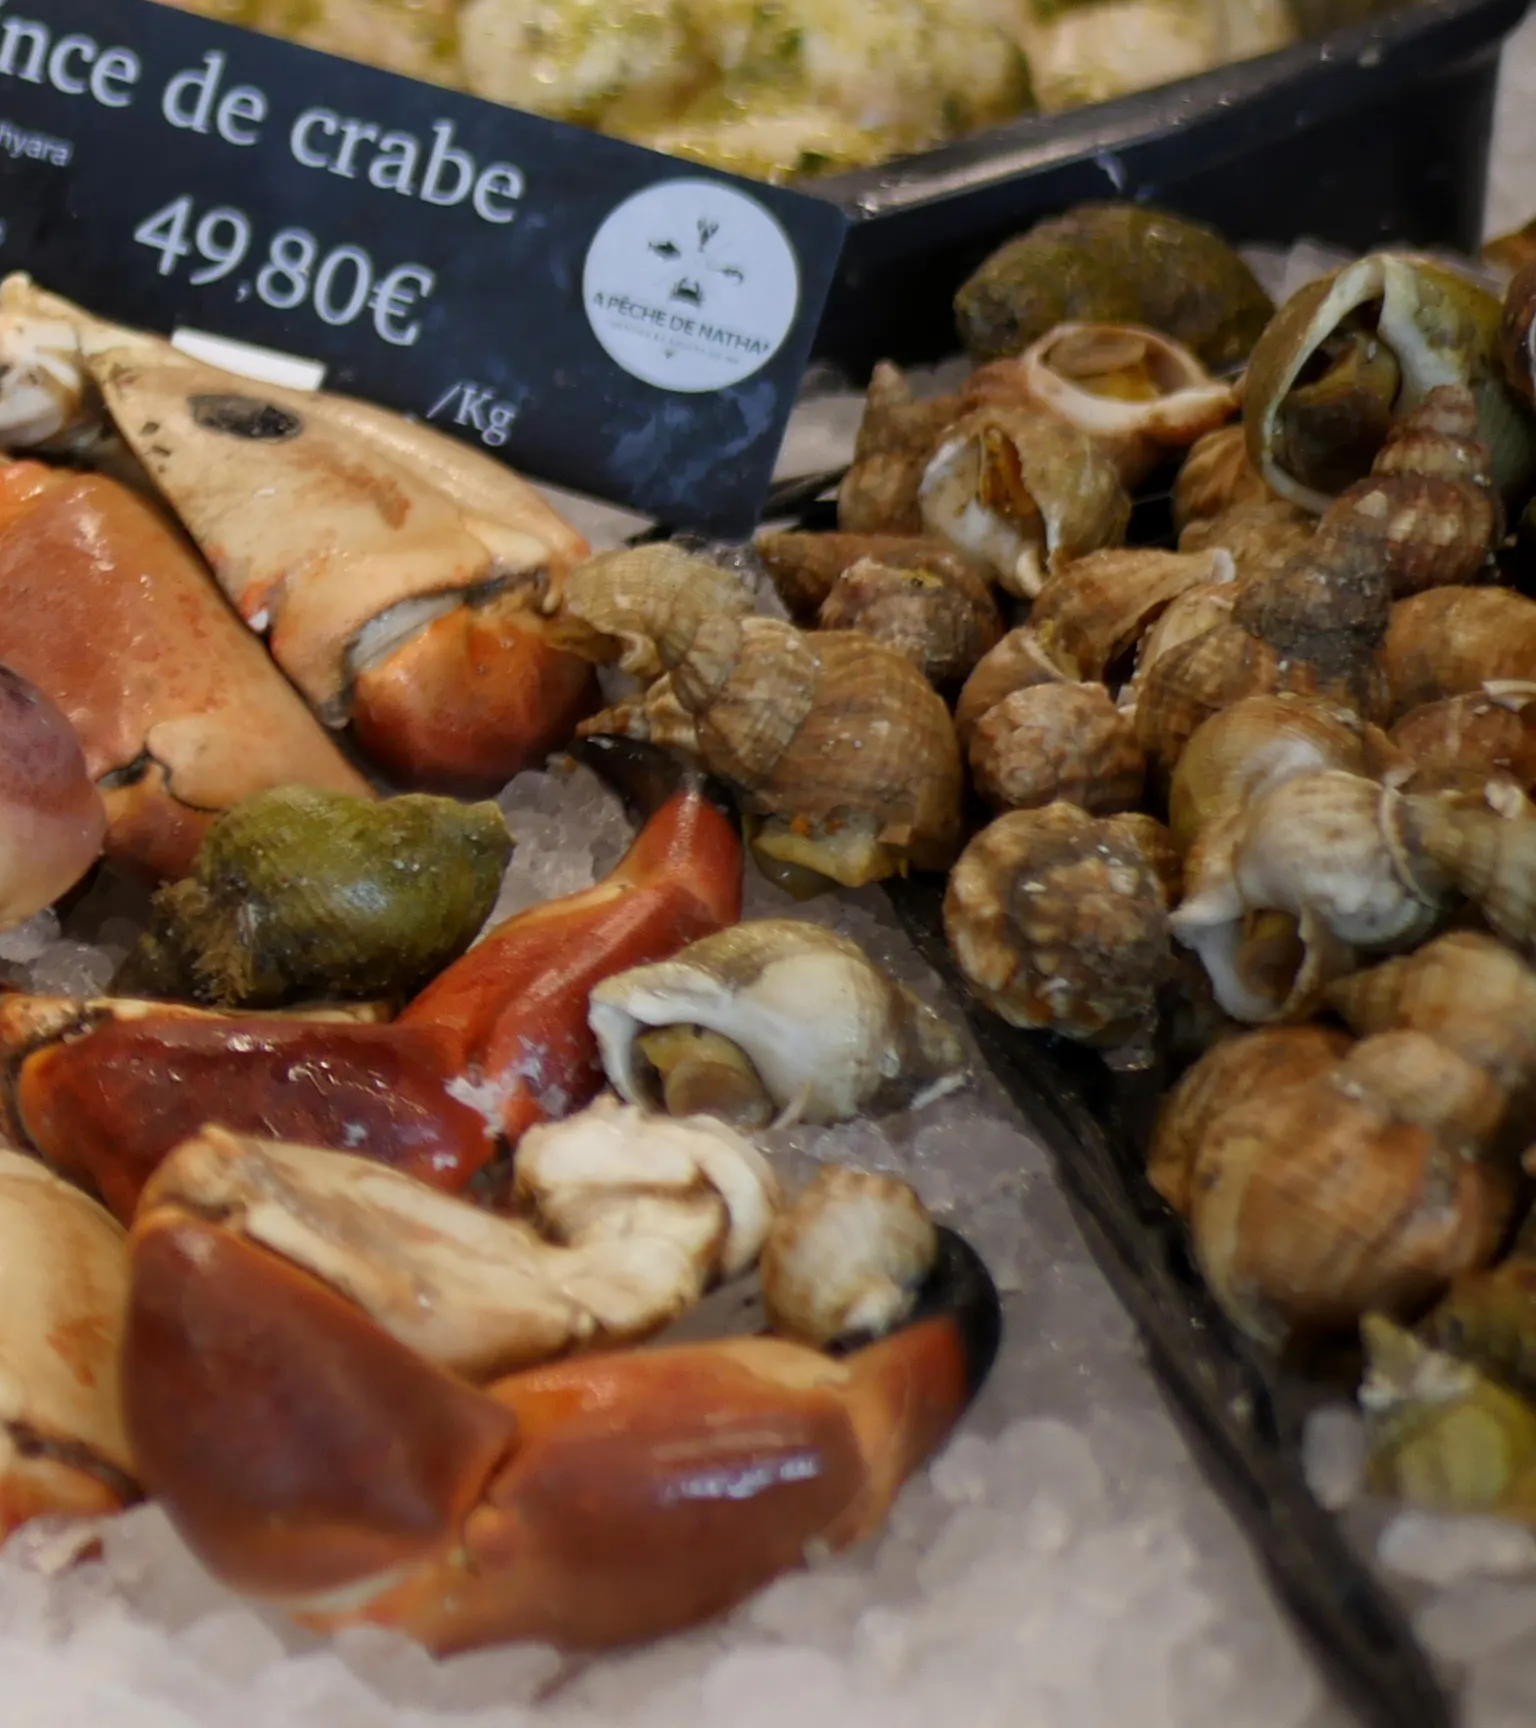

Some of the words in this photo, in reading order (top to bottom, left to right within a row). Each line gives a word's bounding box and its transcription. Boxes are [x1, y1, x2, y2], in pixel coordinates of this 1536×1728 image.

[162, 50, 266, 146] de
[290, 108, 523, 223] crabe
[133, 196, 435, 346] 49,80€
[669, 316, 697, 336] DE
[427, 379, 518, 446] /Kg
